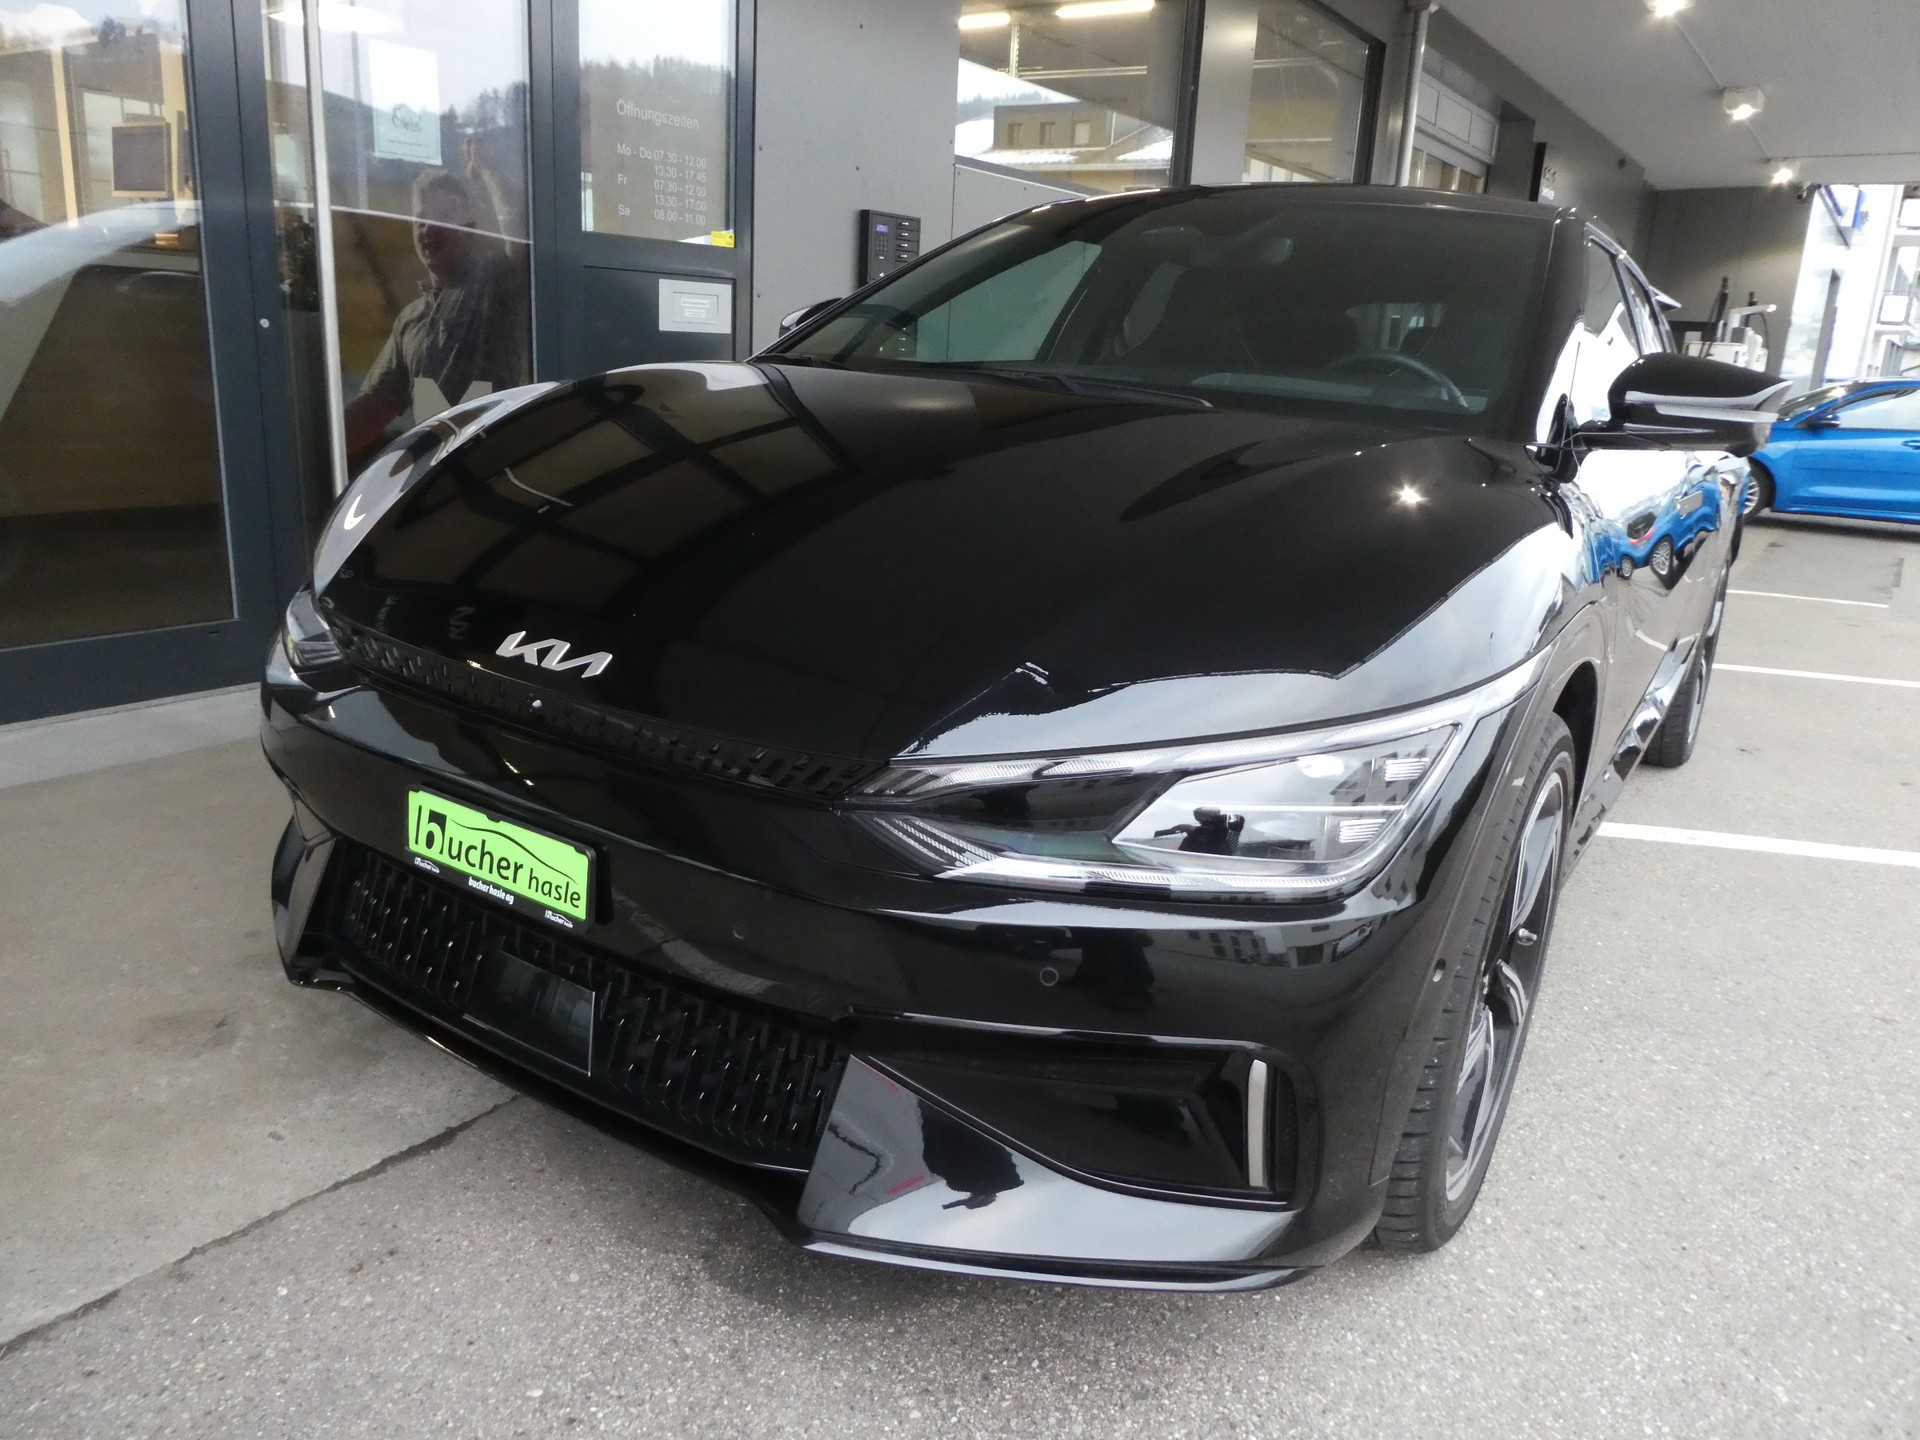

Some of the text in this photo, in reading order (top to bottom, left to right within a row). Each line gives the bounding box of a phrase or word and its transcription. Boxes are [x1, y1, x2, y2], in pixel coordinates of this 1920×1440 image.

[616, 98, 700, 129] Öffnungszeiten
[617, 143, 631, 156] Mo
[640, 147, 652, 159] Do
[654, 150, 677, 164] 07.30
[685, 156, 707, 169] 12.00
[617, 174, 628, 185] Fr
[654, 180, 677, 192] 07.30
[654, 165, 677, 178] 13.30
[618, 204, 631, 216] Sa
[654, 195, 677, 207] 13.30
[495, 630, 613, 679] KIA
[468, 876, 515, 905] bucher hasle ag
[528, 867, 581, 909] hasle
